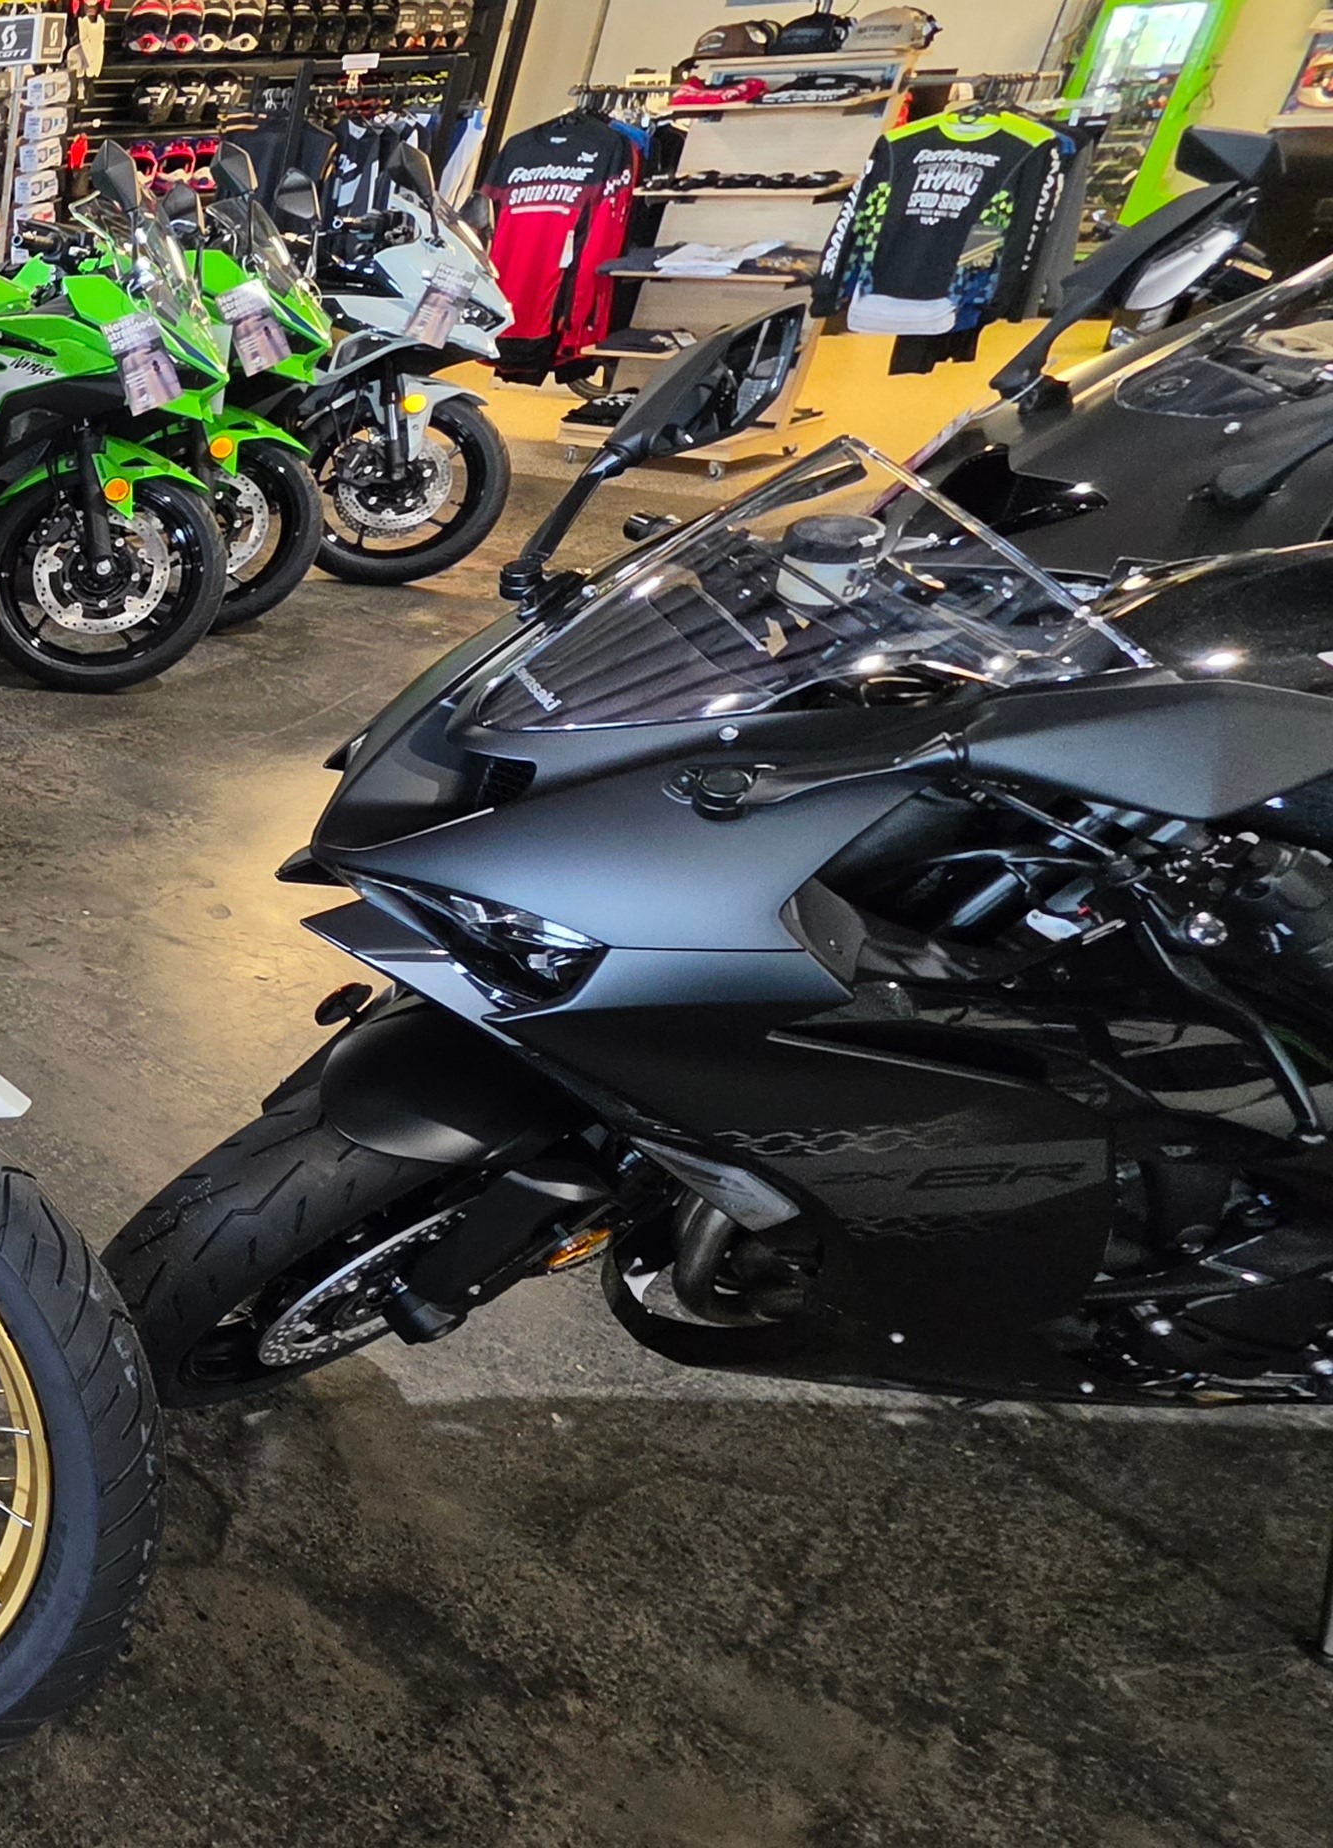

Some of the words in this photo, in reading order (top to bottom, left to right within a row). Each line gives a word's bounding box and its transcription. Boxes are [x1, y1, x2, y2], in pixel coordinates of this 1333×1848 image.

[913, 148, 1001, 167] FASTHOUSE
[507, 164, 594, 185] FASTHOUSE
[108, 317, 153, 343] stranded
[10, 354, 56, 377] Ninja
